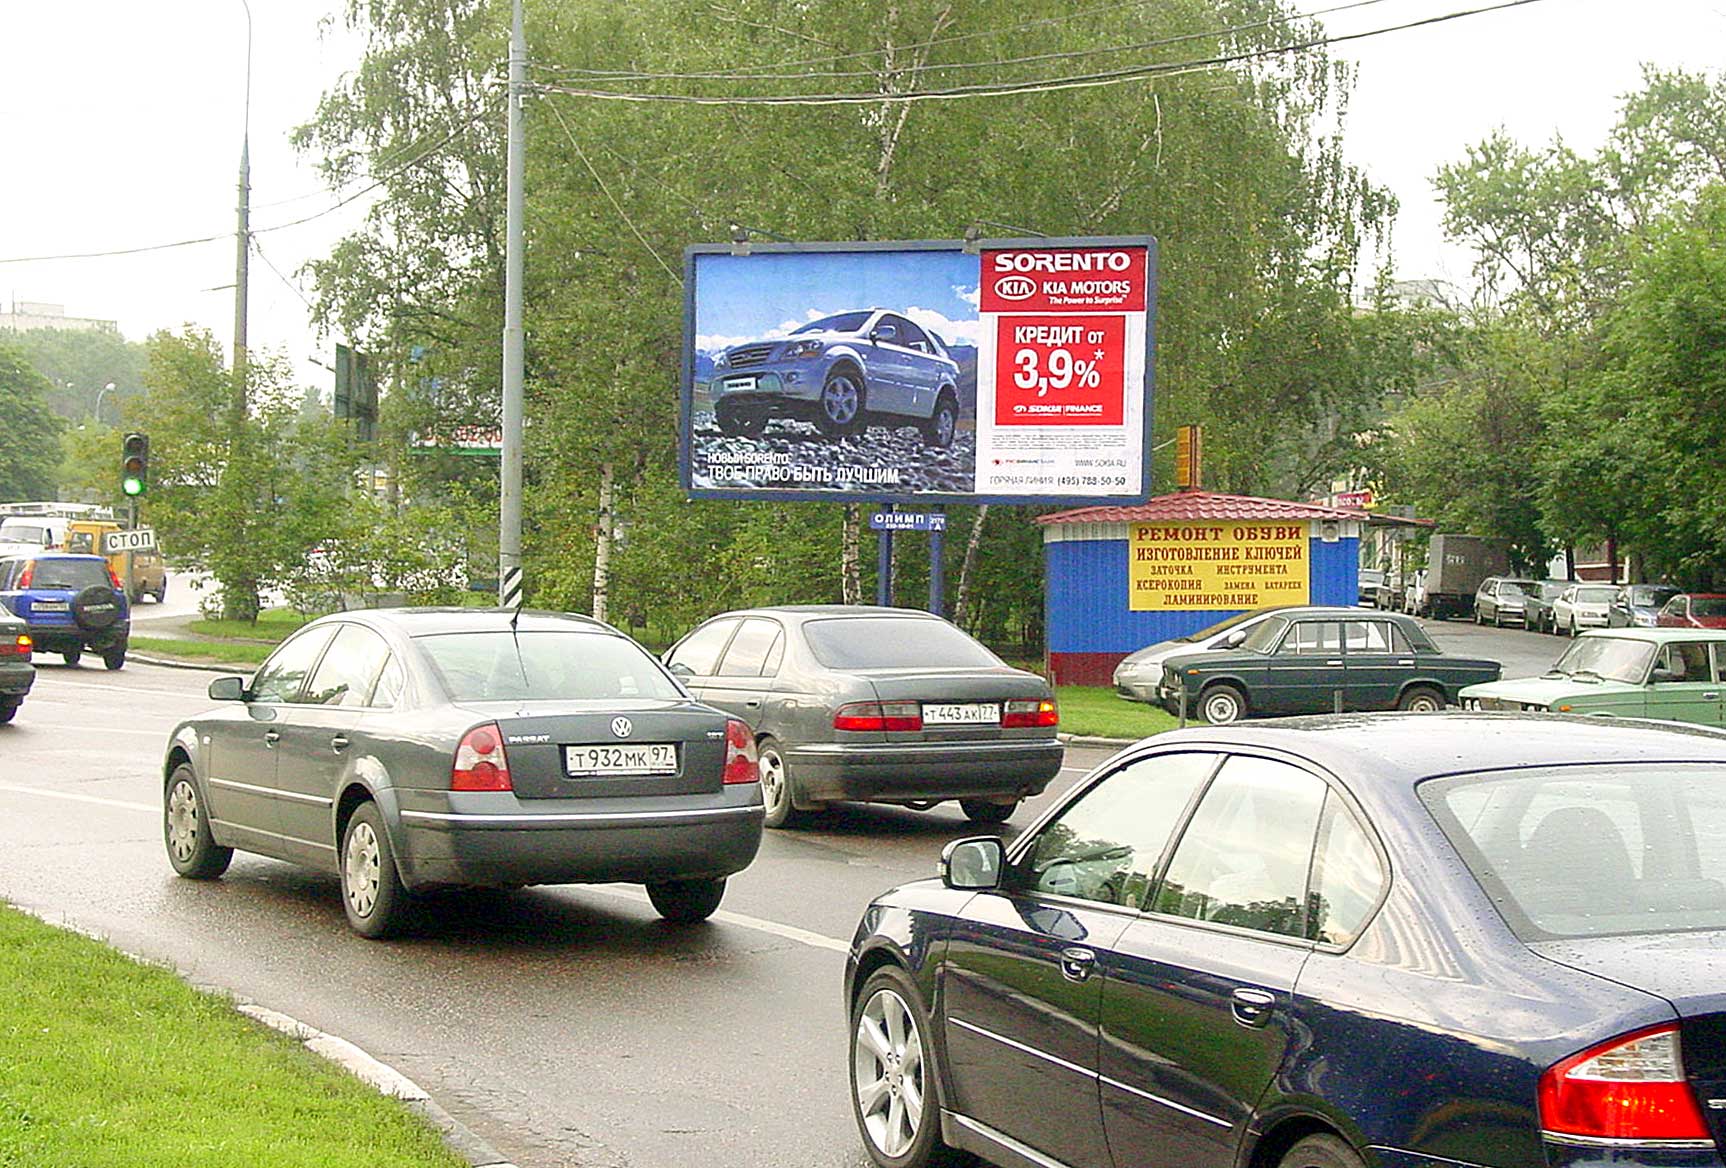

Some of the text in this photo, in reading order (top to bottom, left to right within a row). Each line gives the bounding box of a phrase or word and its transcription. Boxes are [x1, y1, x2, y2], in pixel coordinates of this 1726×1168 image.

[994, 252, 1131, 272] SORENTO
[1002, 282, 1030, 294] KIA
[1043, 280, 1130, 294] KIA MOTORS
[1015, 327, 1083, 347] КРЕДИТ
[745, 466, 790, 481] ПРАВО
[793, 467, 832, 482] БЫТЬ
[836, 467, 899, 484] ЛУЧШИМ
[874, 514, 925, 524] ОЛИМП
[109, 532, 151, 549] СТОП
[1136, 526, 1302, 541] РЕМОНТ ОБУВИ
[1137, 544, 1302, 561] ИЗГОТОВЛЕНИЕ КЛЮЧЕЙ
[1150, 564, 1288, 576] ЗАТОЧКА ИНСТРУМЕНТА
[1136, 579, 1202, 591] КСЕРОКОПИЯ
[1224, 581, 1256, 590] ЗАМЕНА
[1163, 593, 1259, 606] ЛАМИНИРОВАНИЕ
